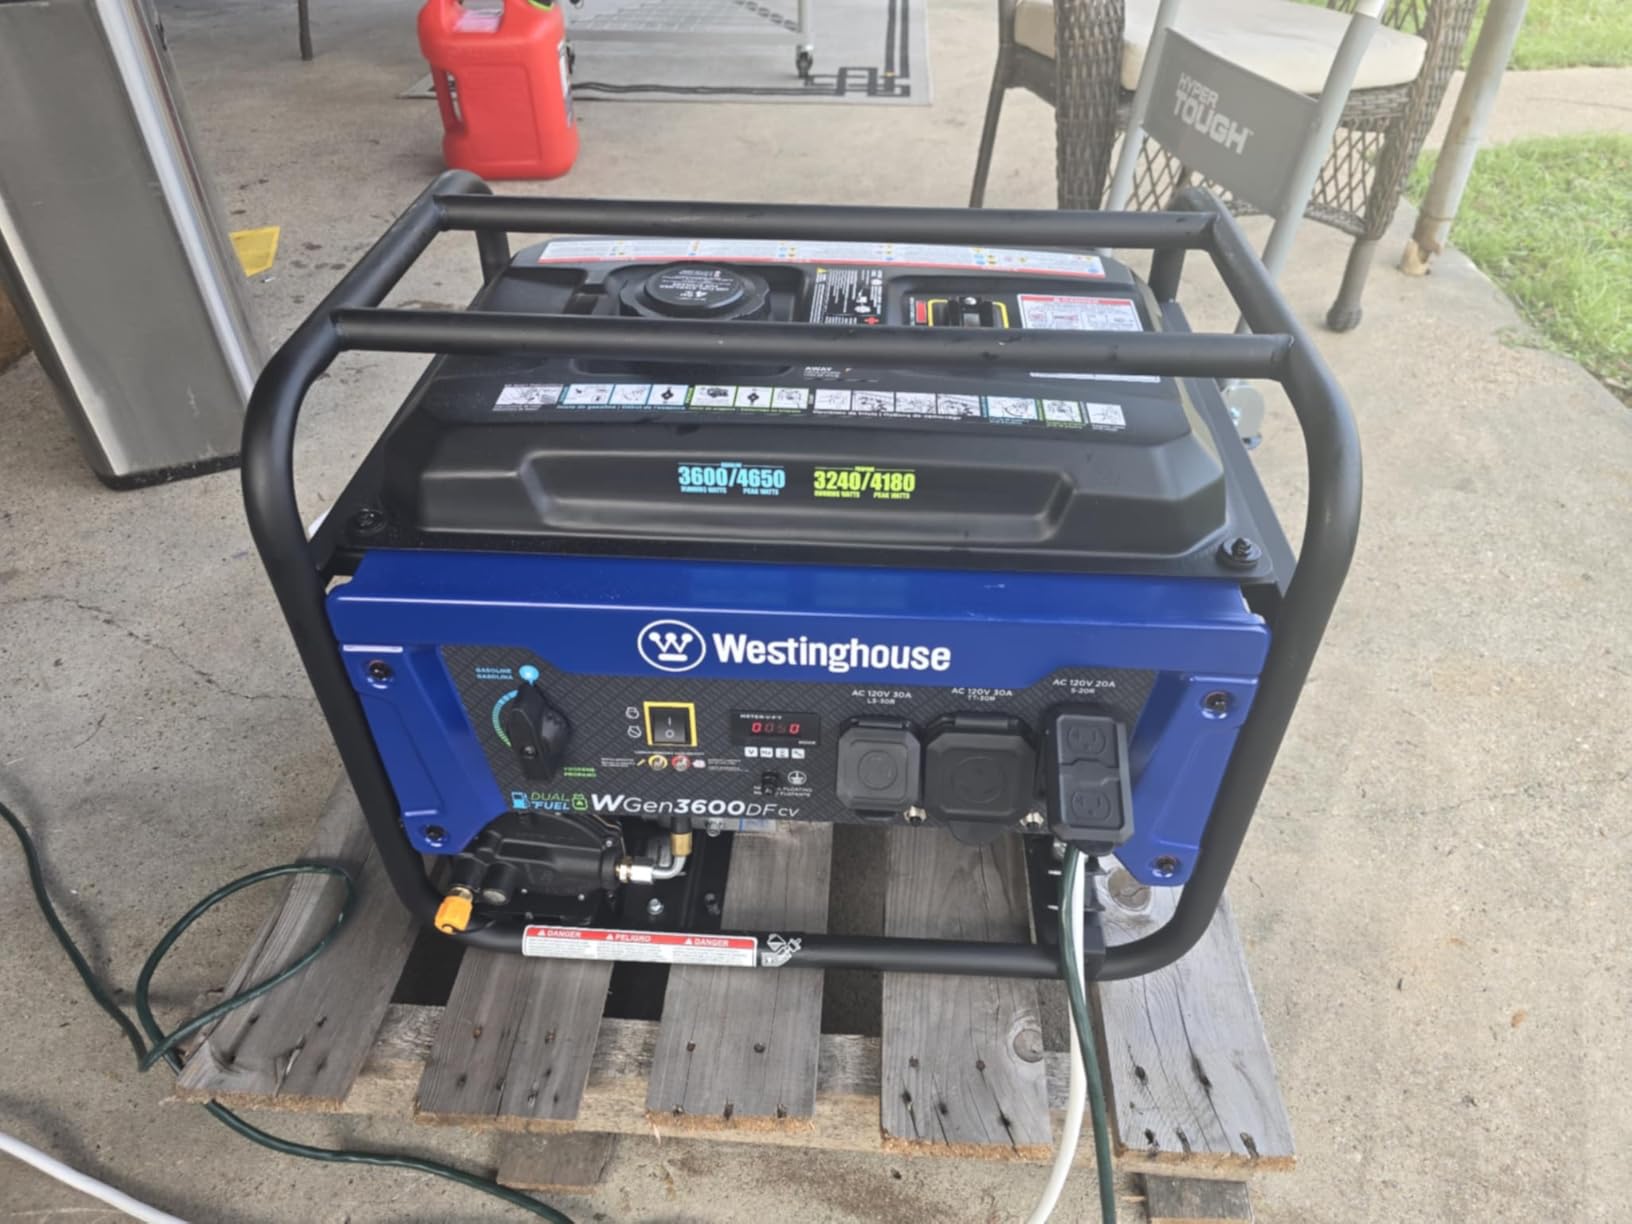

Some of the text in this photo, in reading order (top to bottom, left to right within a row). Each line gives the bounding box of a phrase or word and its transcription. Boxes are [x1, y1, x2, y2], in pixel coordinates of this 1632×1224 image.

[1174, 89, 1249, 155] TOUGH
[678, 465, 786, 489] 3600/4650
[814, 470, 916, 493] 3240/4180
[712, 632, 952, 673] Westinghouse
[1052, 678, 1068, 686] AC
[1069, 679, 1094, 687] 120V
[867, 690, 890, 698] 120V
[530, 792, 569, 802] DUAL
[534, 801, 571, 811] FUEL
[546, 930, 582, 939] DANGER
[615, 934, 652, 943] PELIGRO
[693, 938, 730, 947] DANGER
